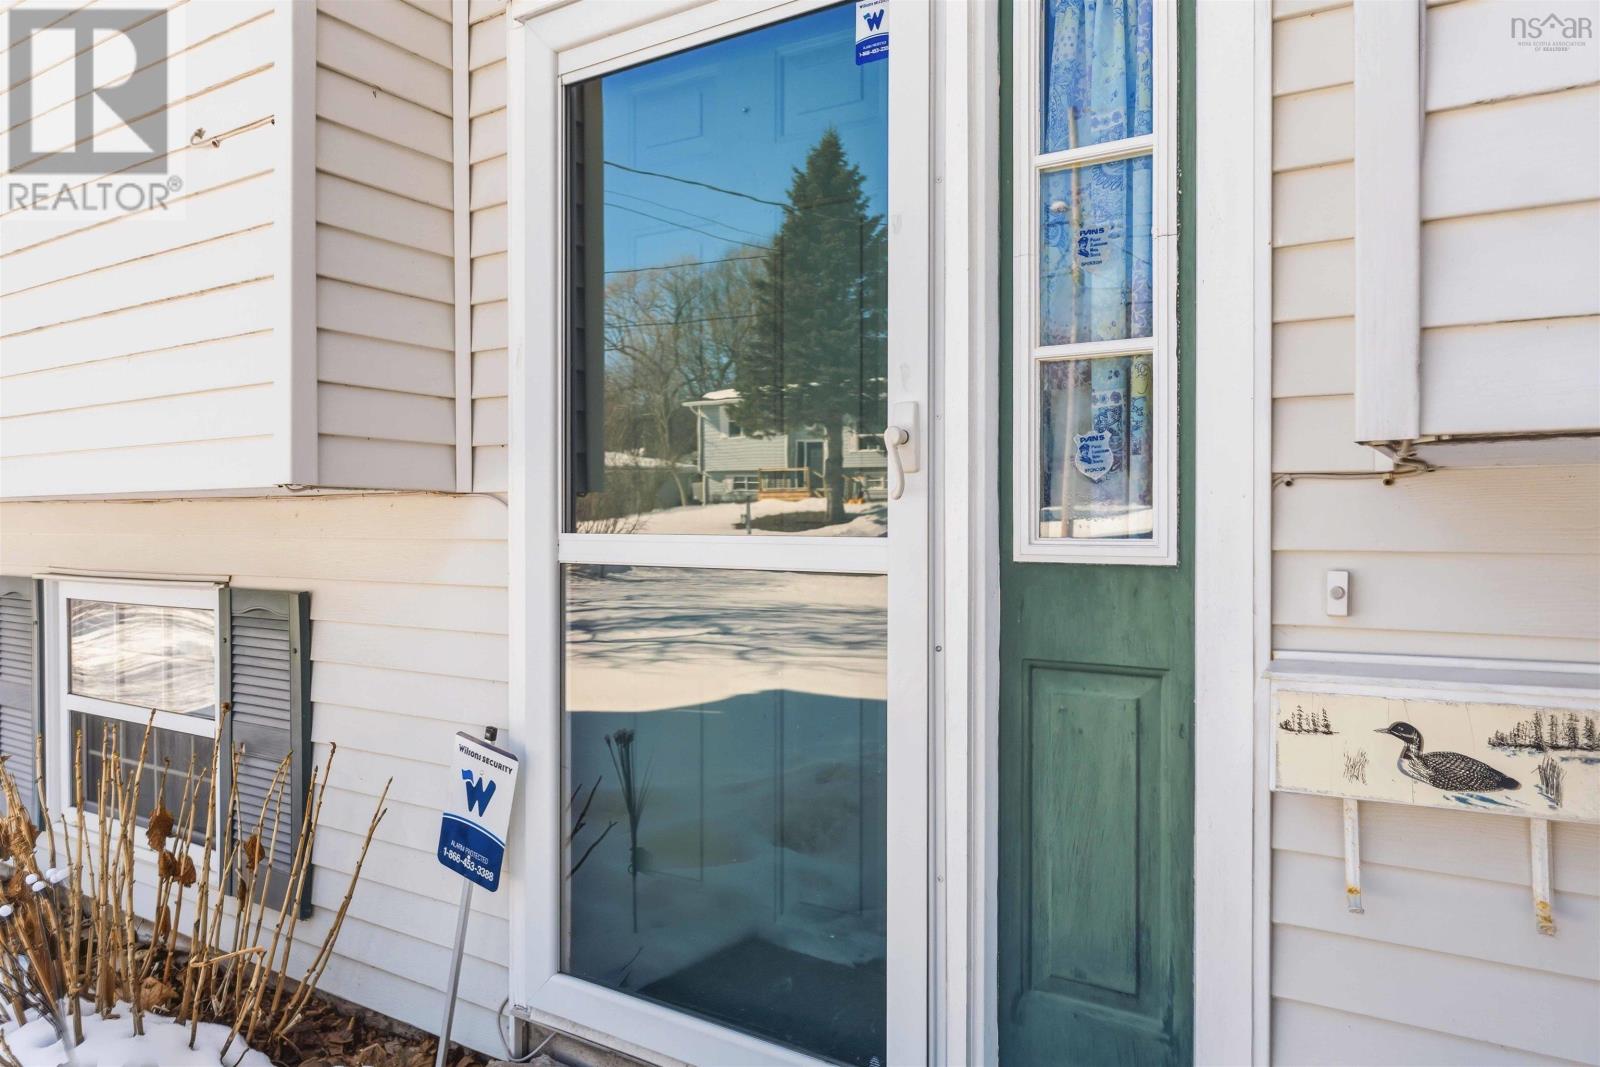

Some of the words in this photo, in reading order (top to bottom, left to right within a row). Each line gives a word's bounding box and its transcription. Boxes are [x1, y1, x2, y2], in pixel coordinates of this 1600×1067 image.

[458, 743, 482, 762] Wilsons
[482, 757, 513, 775] SECURITY
[465, 776, 497, 818] W
[464, 847, 489, 865] PROTECTED
